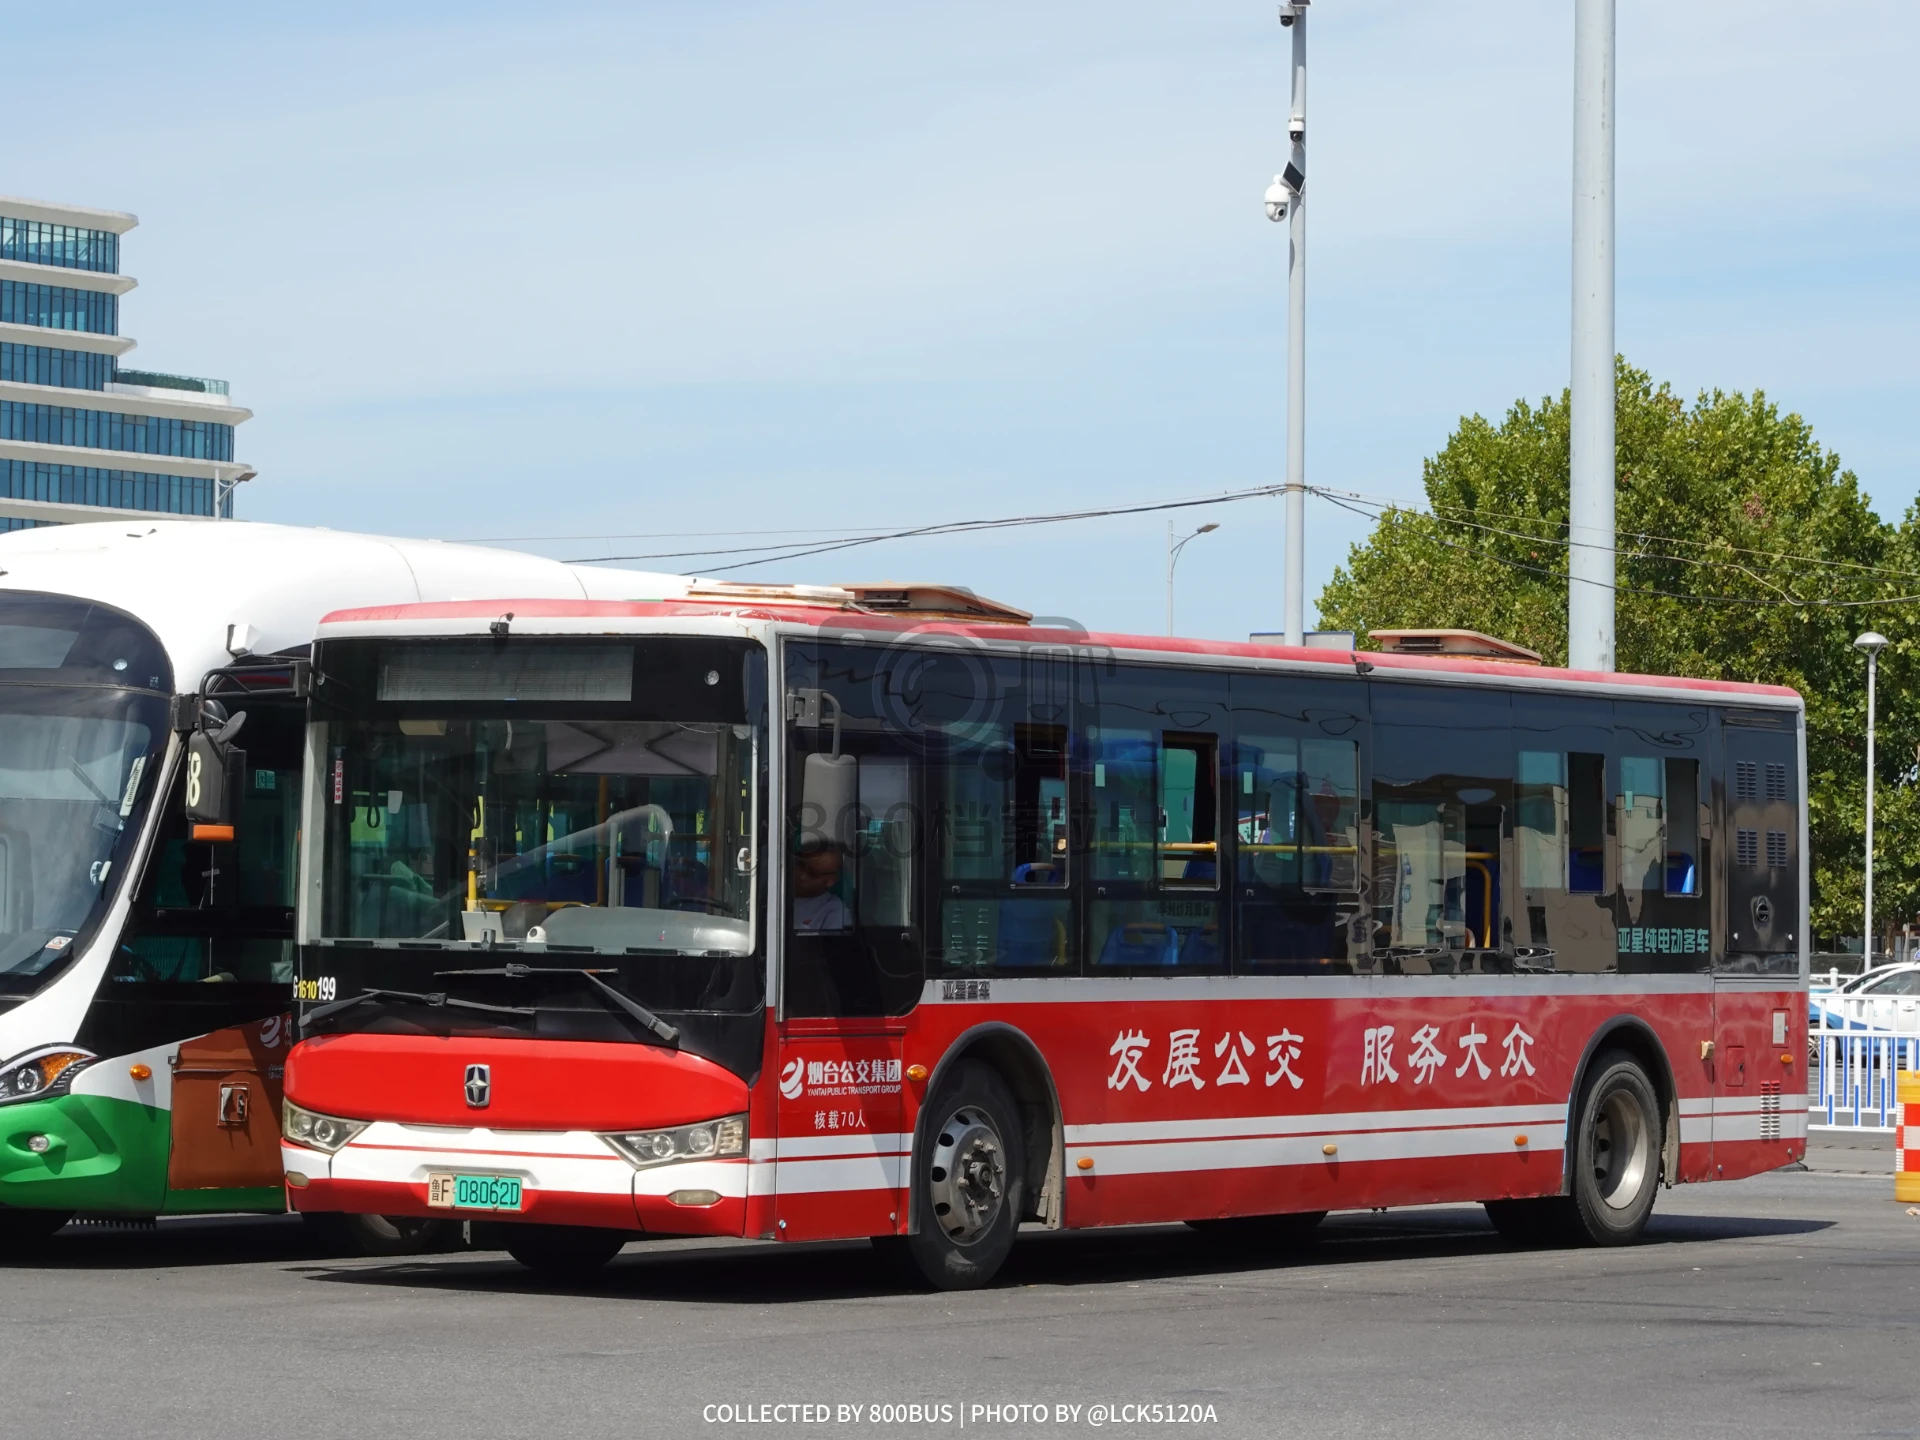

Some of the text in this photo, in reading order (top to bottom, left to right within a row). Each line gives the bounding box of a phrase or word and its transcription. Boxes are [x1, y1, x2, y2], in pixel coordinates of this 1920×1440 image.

[1618, 927, 1709, 954] 亚星纯电动客车
[1107, 1022, 1537, 1092] 发展公交 服务大众
[807, 1059, 902, 1085] 烟台公交集团
[807, 1087, 827, 1097] YANTAI
[827, 1086, 848, 1096] PUBLIC
[848, 1085, 881, 1095] TRANSPORT
[814, 1109, 866, 1130] 核载70人
